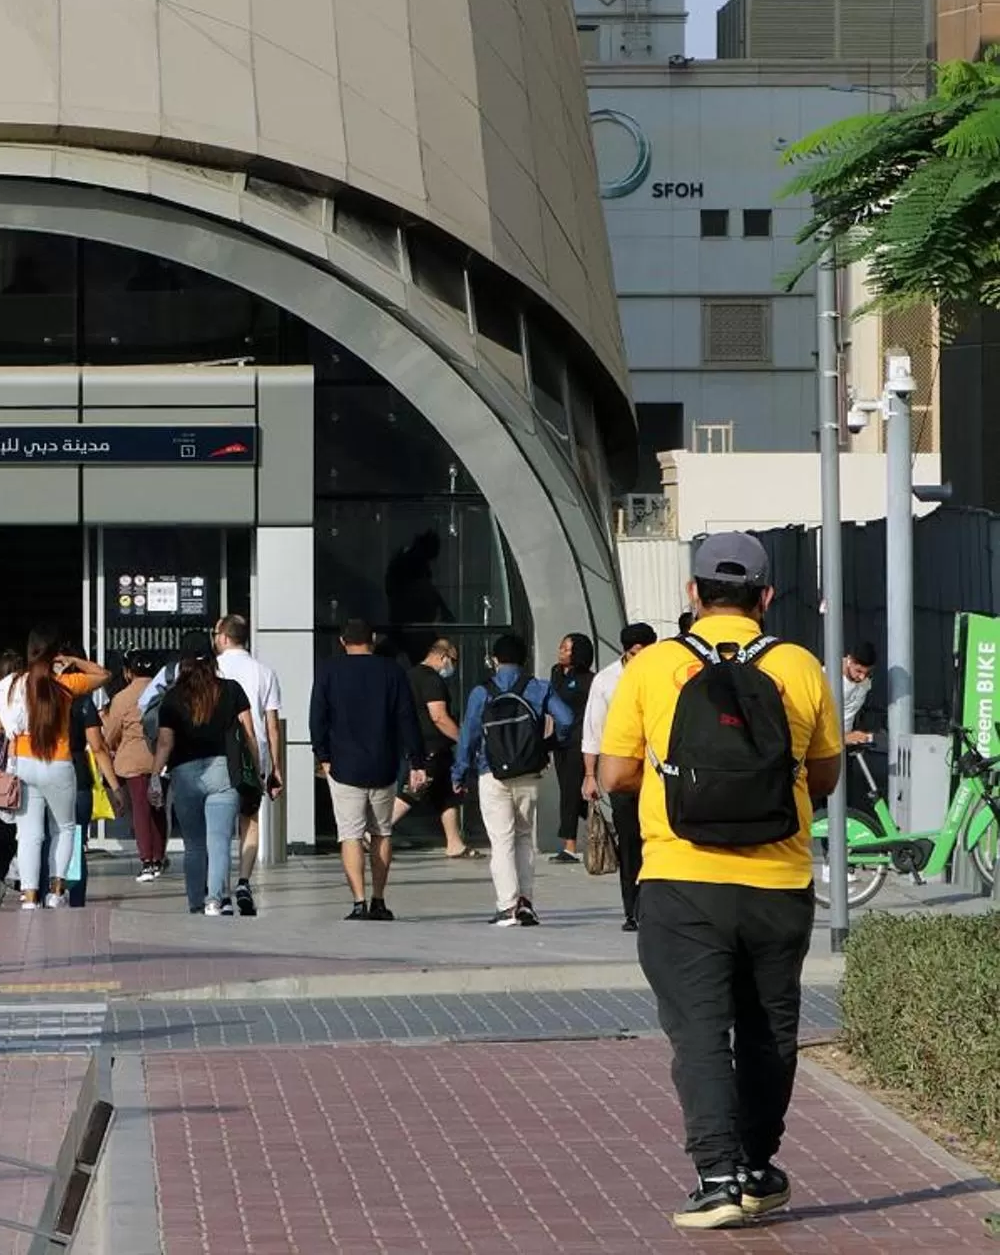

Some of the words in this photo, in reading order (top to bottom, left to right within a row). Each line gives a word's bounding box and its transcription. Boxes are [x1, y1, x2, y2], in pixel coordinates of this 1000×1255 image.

[652, 183, 703, 198] SFOH
[23, 441, 58, 458] دبي
[62, 438, 110, 455] مدينة
[976, 641, 995, 693] BIKE
[976, 699, 992, 759] reem
